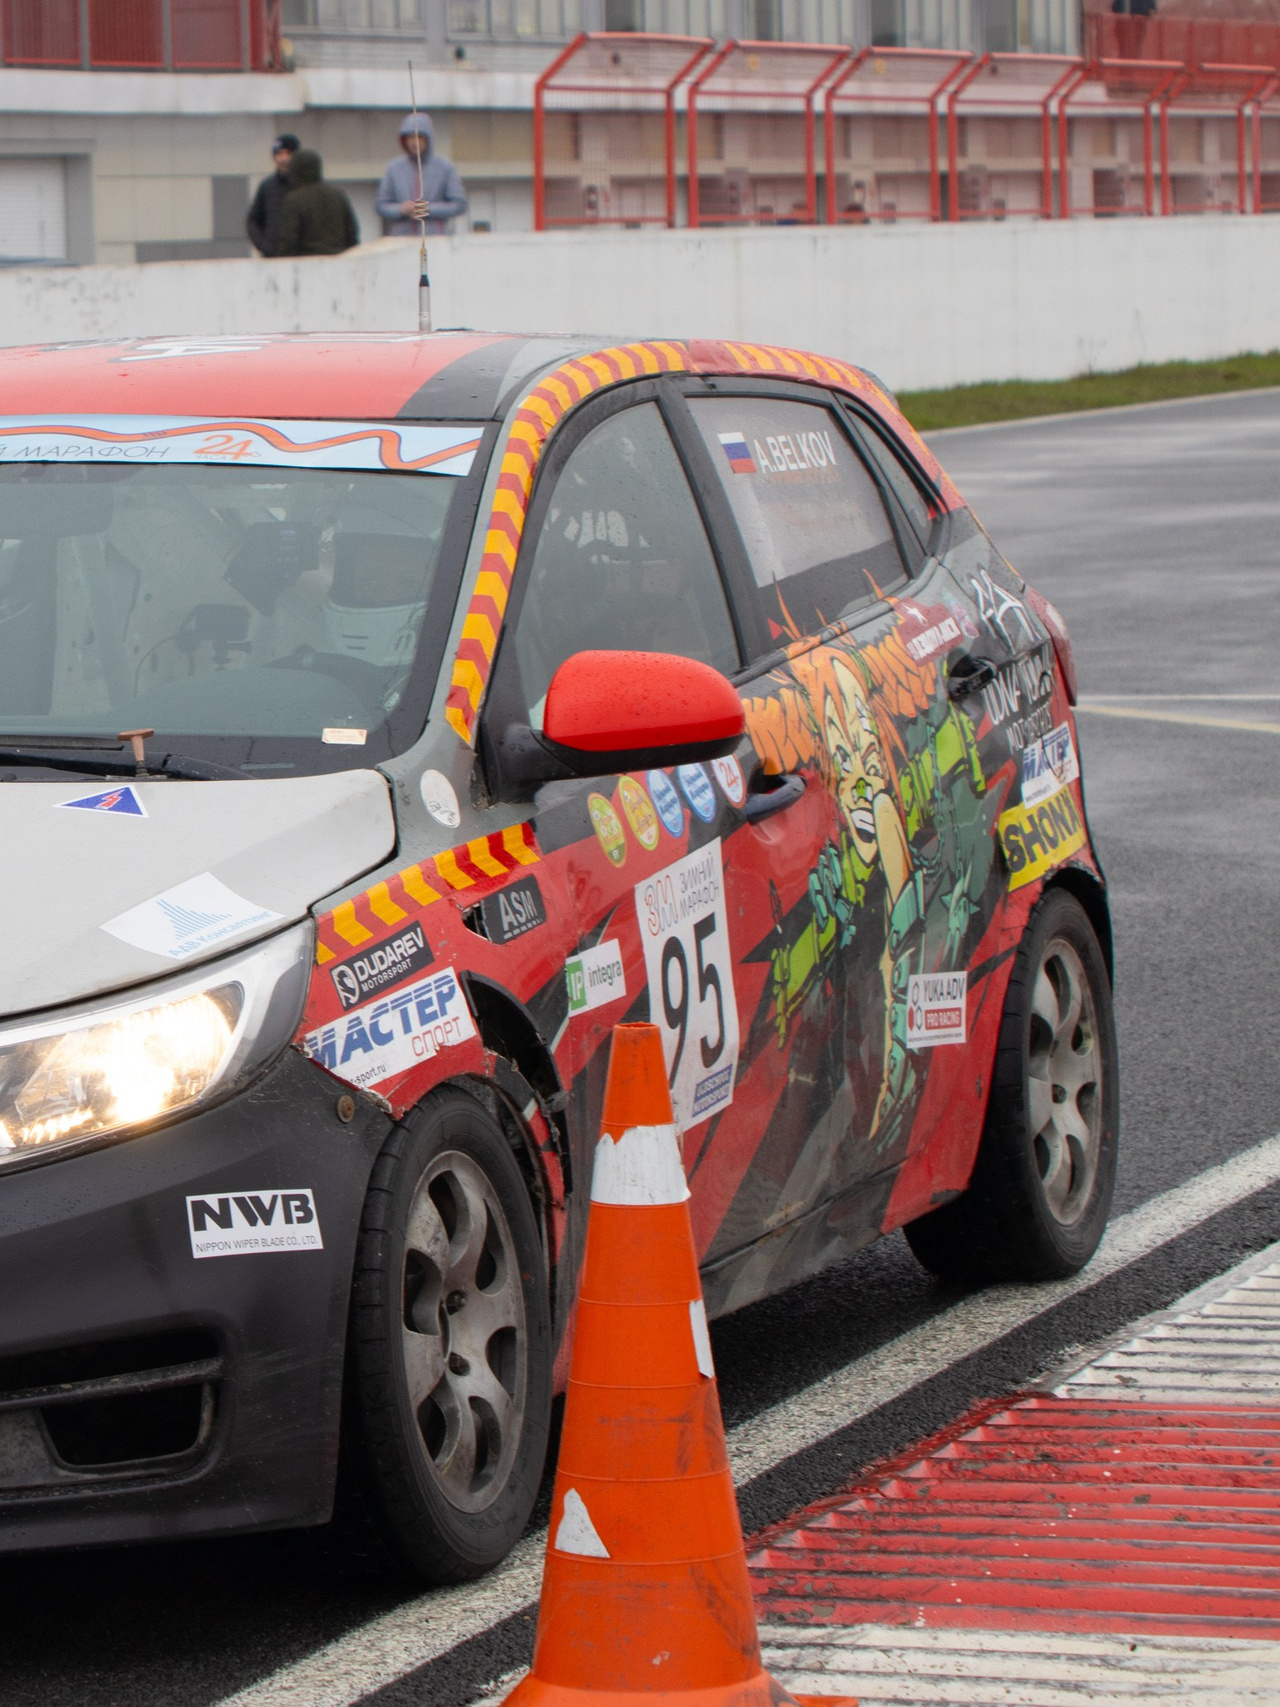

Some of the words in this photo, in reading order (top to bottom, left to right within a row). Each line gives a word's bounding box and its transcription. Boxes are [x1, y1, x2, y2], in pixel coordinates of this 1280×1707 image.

[13, 444, 170, 460] МАРАФОН
[193, 434, 253, 460] 24
[498, 889, 538, 932] ASM
[354, 927, 425, 981] DUDAREV
[588, 960, 622, 988] integra
[361, 958, 412, 992] MOTORSPORT
[305, 973, 456, 1071] МАСТЕР
[661, 912, 725, 1092] 95
[411, 1016, 463, 1057] СПОРТ
[190, 1193, 315, 1232] NWB
[195, 1240, 232, 1253] NIPPON
[233, 1238, 260, 1250] WIPER
[261, 1236, 285, 1248] BLADE
[302, 1235, 319, 1245] LTD.
